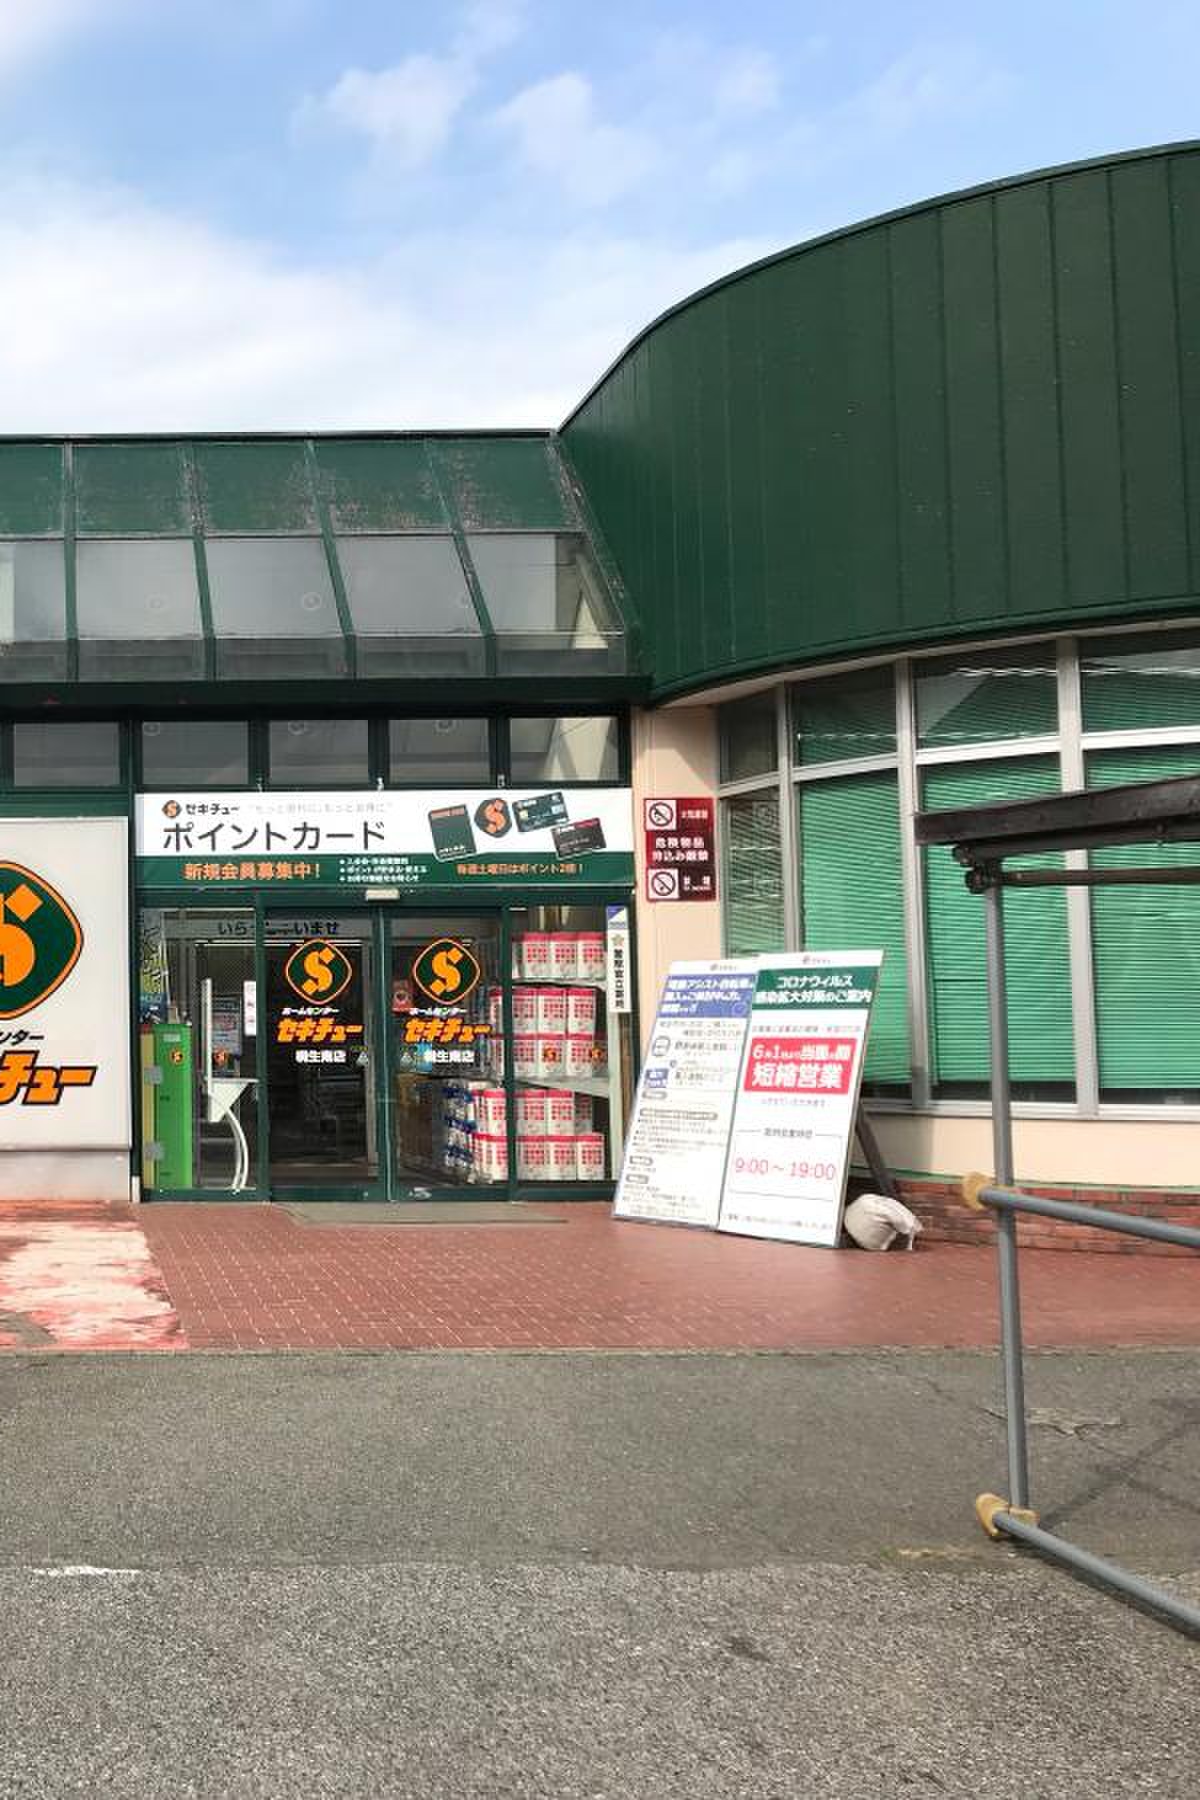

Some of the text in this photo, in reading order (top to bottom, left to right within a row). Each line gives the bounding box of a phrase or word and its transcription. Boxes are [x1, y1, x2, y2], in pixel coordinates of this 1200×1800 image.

[186, 803, 240, 815] セキチュー
[163, 821, 385, 852] ポイントカード
[275, 1017, 363, 1043] セキチュー
[404, 1017, 492, 1043] セキチュー
[750, 1061, 843, 1089] 短縮営業
